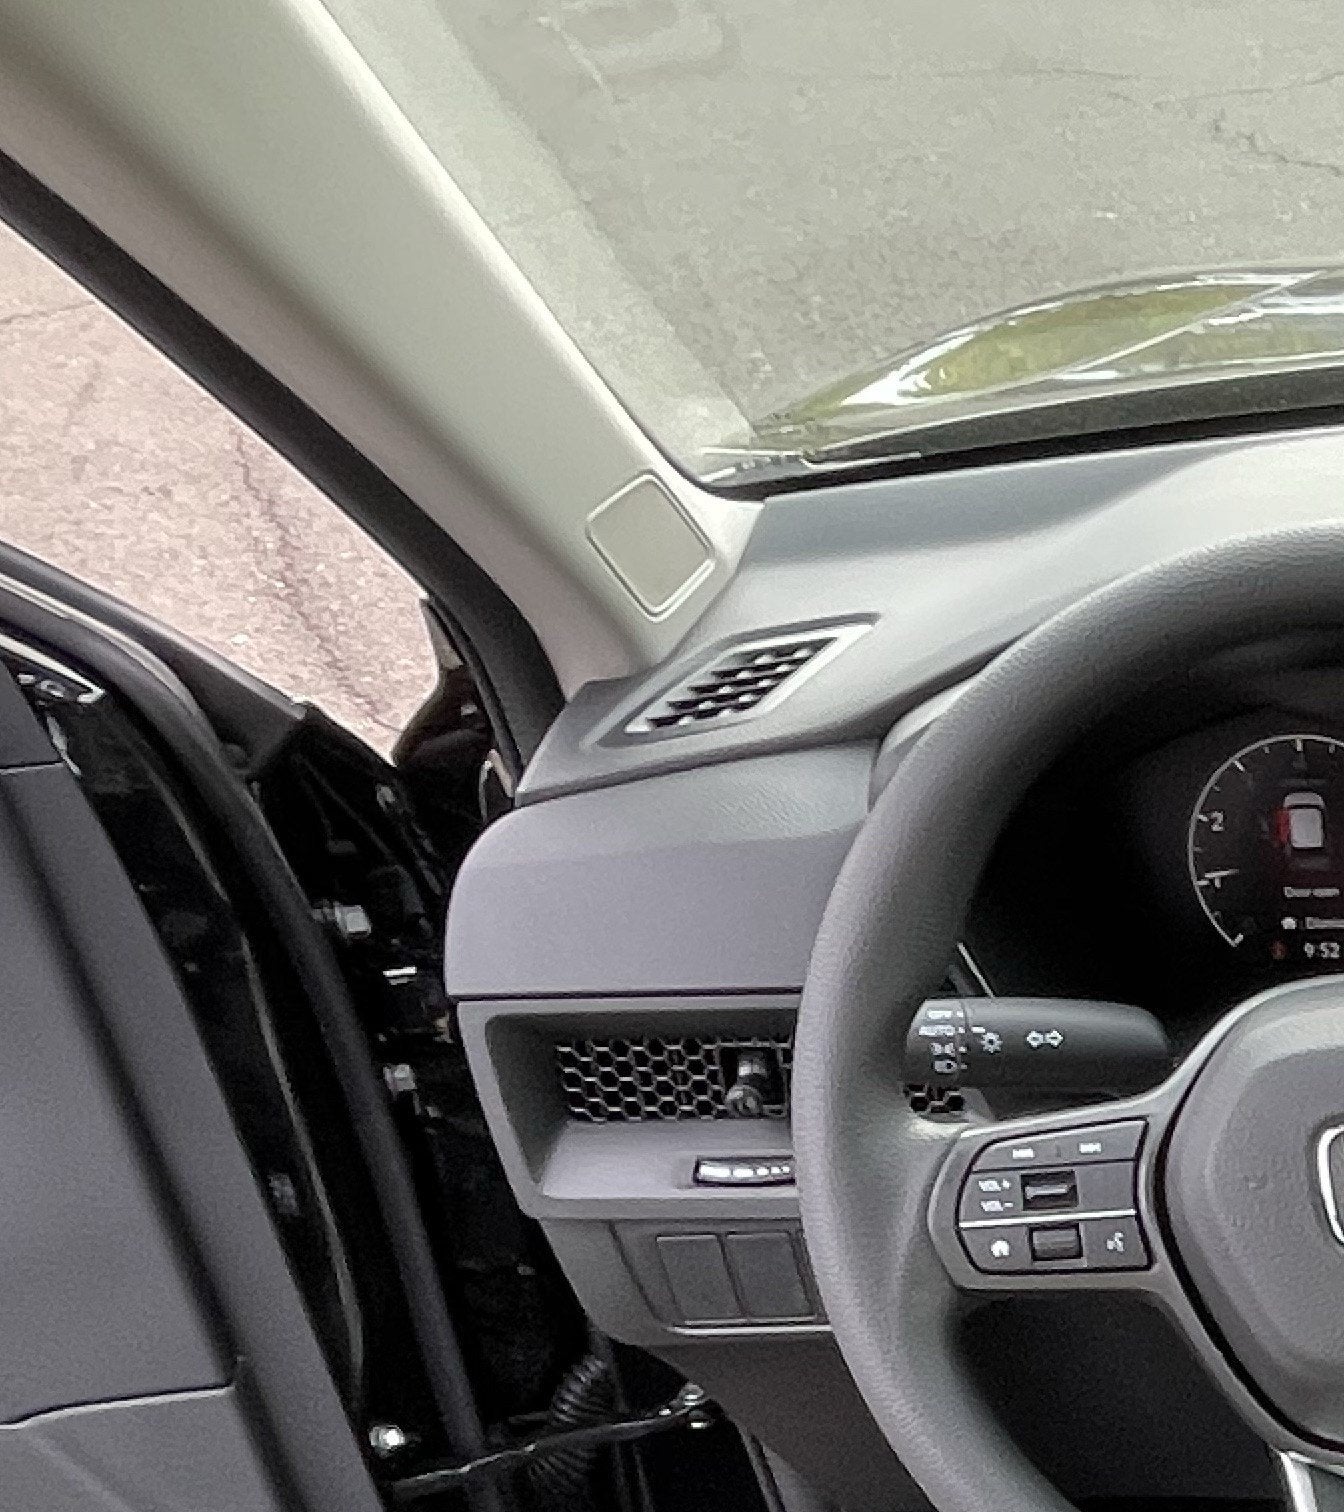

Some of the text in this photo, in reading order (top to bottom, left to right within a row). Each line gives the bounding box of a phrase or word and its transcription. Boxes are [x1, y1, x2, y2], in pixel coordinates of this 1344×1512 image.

[1210, 811, 1225, 832] 2
[1304, 942, 1341, 958] 9:52
[918, 1023, 956, 1037] AUTO
